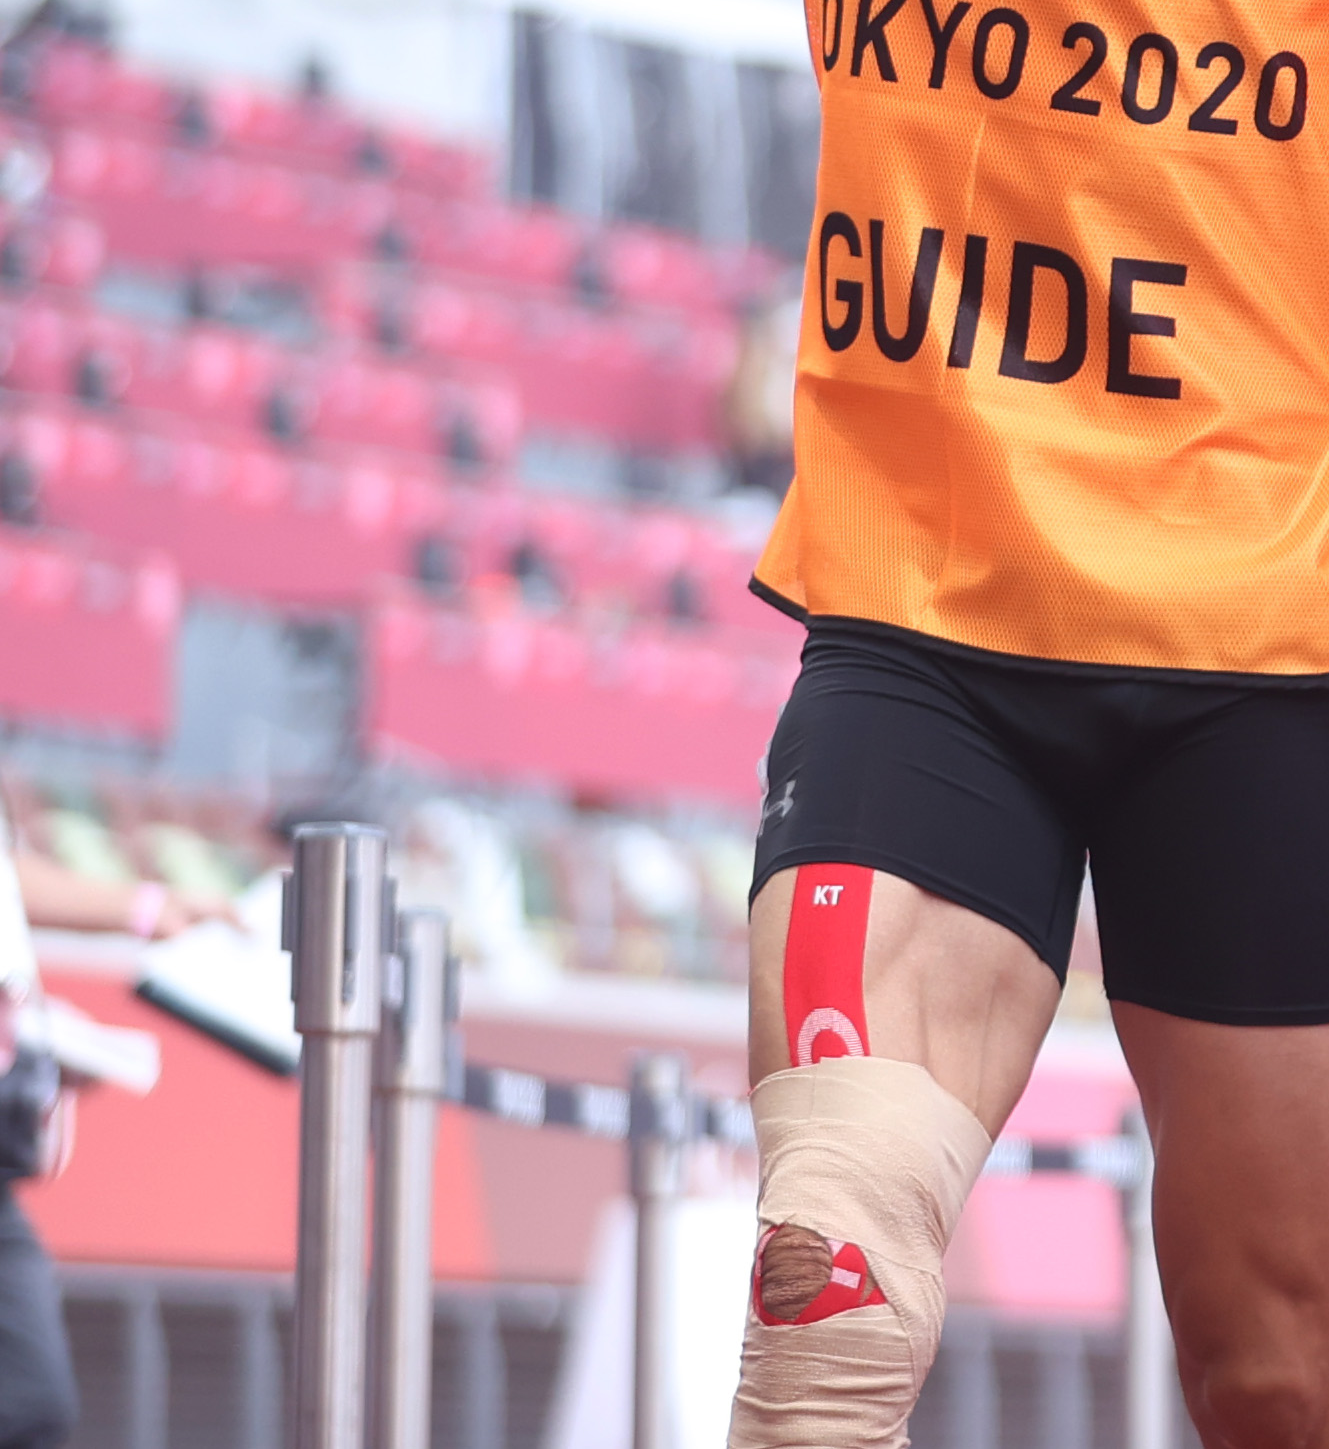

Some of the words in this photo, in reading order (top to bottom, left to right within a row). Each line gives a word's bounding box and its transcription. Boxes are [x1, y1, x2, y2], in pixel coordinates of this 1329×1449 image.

[1050, 21, 1308, 142] 2020
[819, 210, 1188, 401] GUIDE
[813, 884, 844, 906] KT
